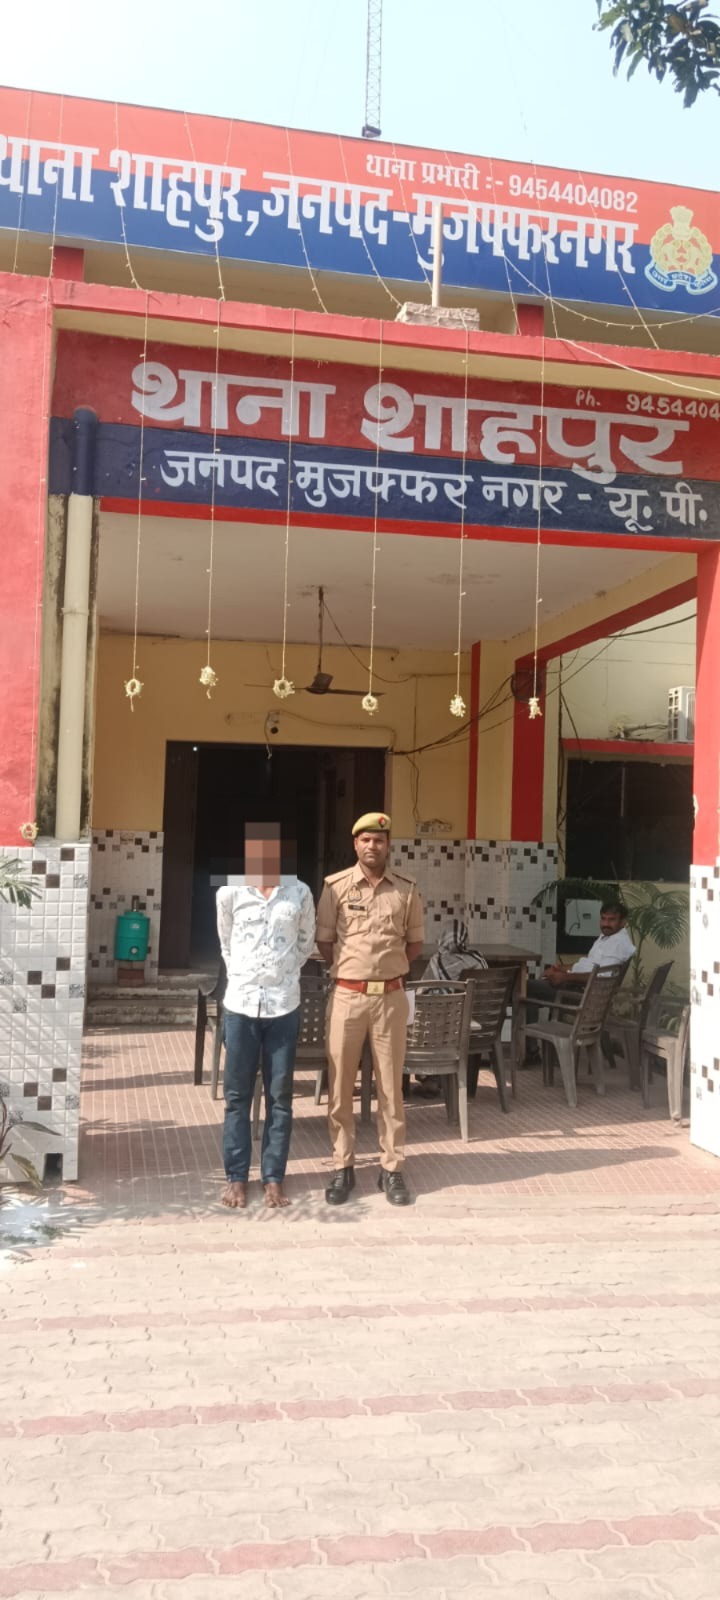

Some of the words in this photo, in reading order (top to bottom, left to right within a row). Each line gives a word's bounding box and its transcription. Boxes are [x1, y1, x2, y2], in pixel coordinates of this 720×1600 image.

[0, 134, 99, 203] थाना
[366, 153, 417, 181] थाना
[421, 162, 480, 190] प्रभारी
[508, 174, 639, 213] 9454404082
[131, 361, 336, 438] थाना
[360, 382, 690, 485] शाहपुर
[575, 389, 601, 407] Ph.
[160, 450, 286, 496] जनपद
[293, 460, 474, 510] मुजफ्फर
[481, 475, 567, 515] नगर
